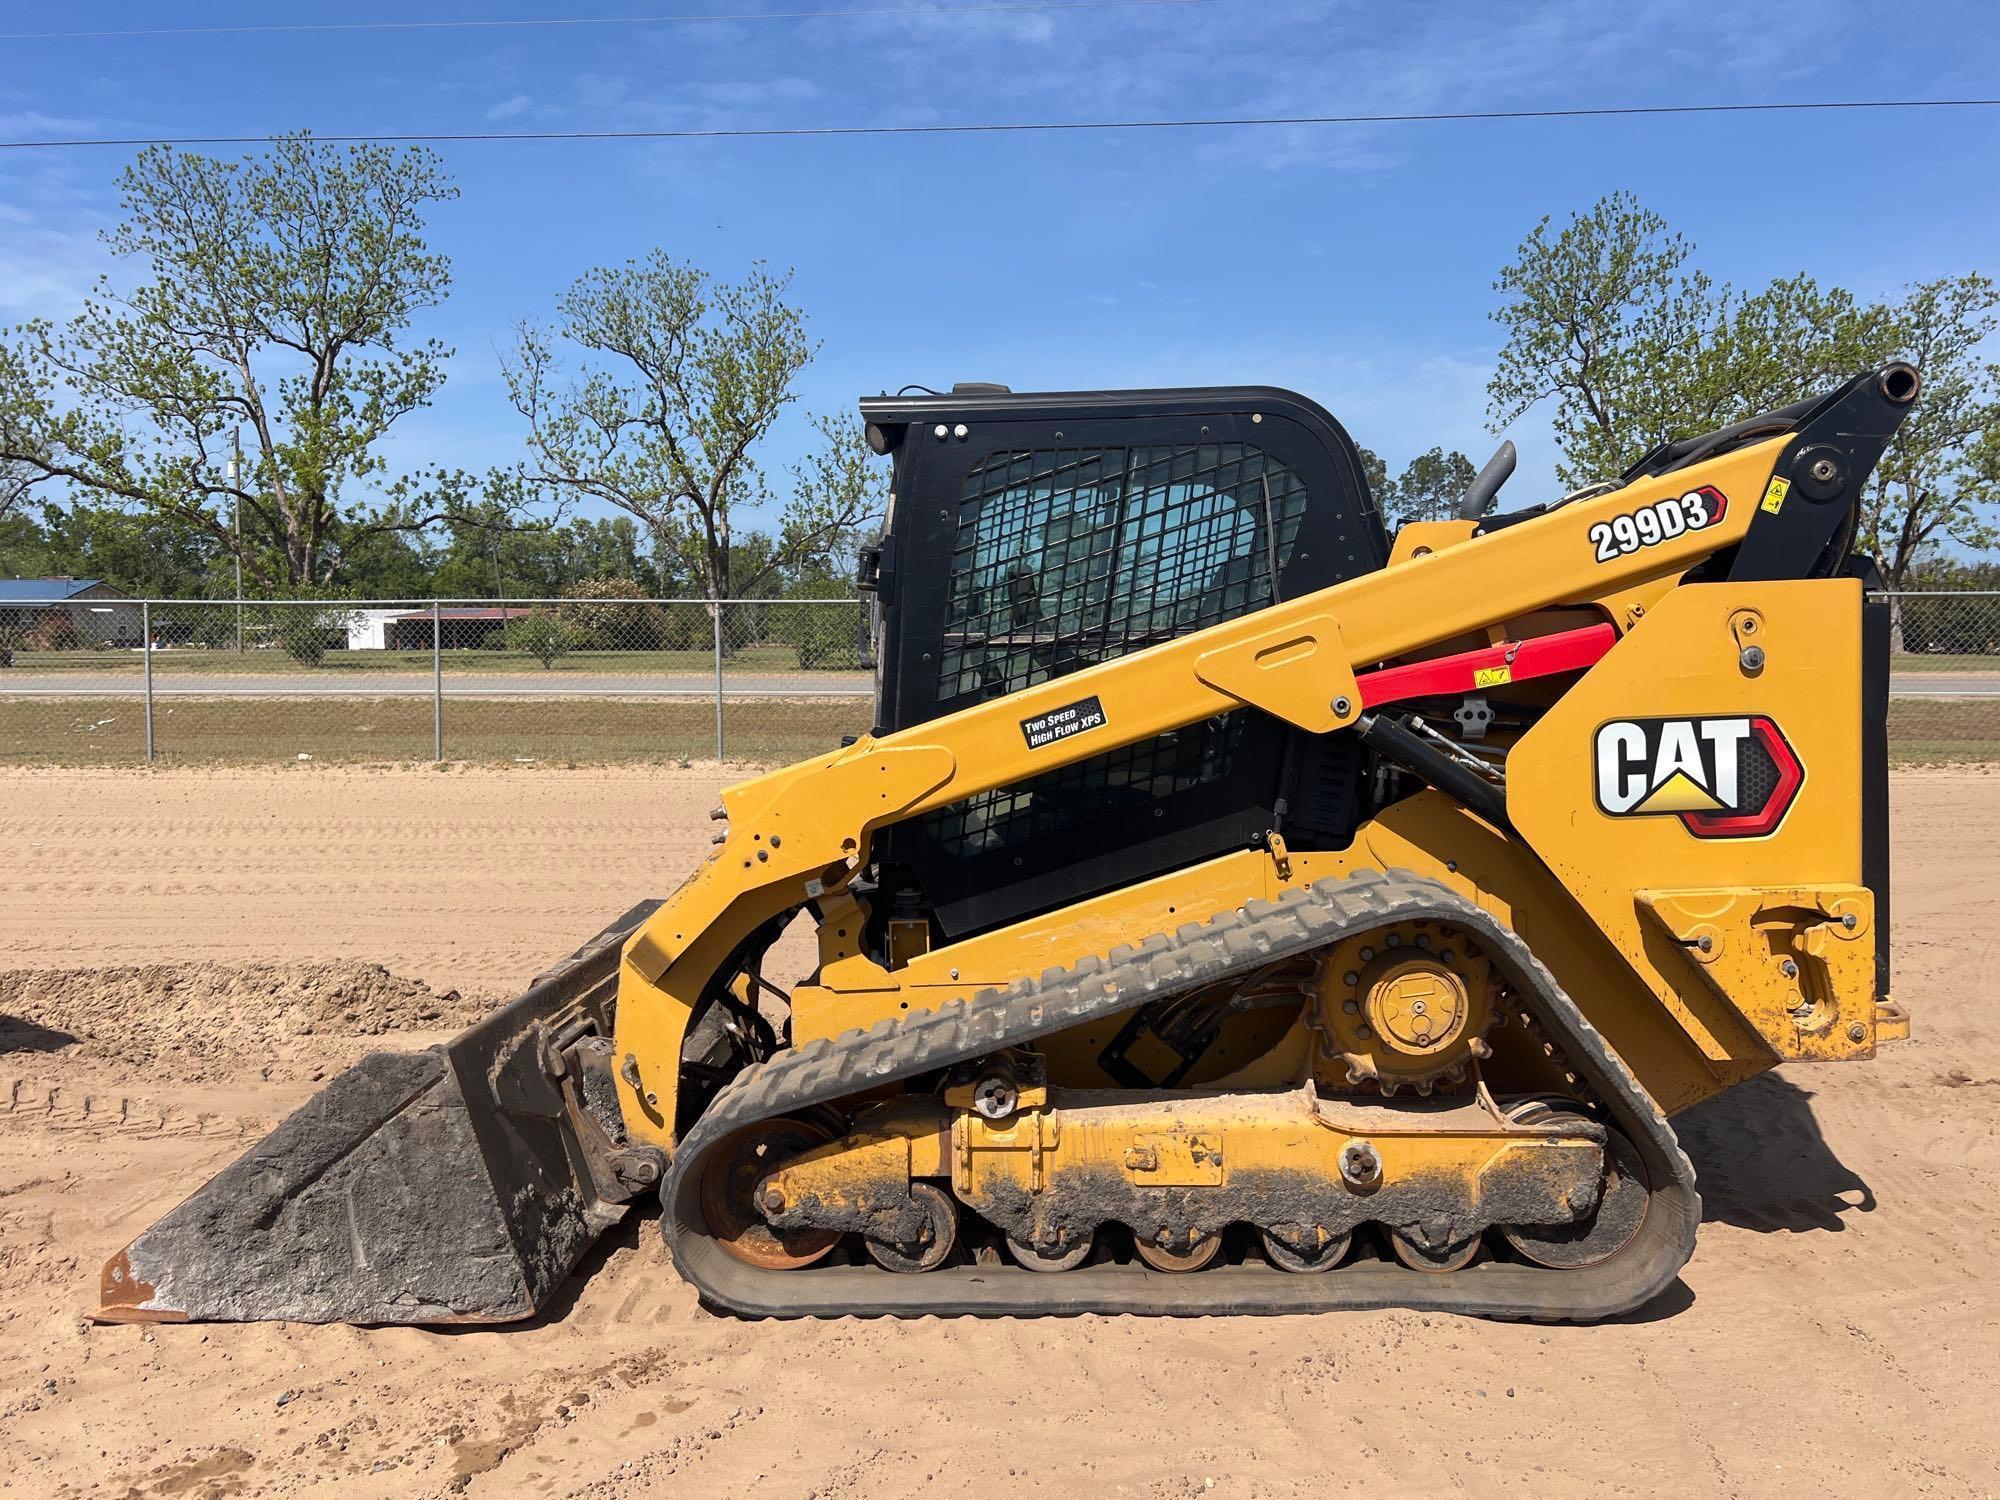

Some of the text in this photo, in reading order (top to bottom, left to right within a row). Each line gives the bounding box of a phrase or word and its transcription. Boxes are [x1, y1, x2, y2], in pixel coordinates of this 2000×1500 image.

[1591, 493, 1708, 560] 299D3
[1081, 713, 1101, 729] XPS
[1598, 719, 1750, 813] CAT
